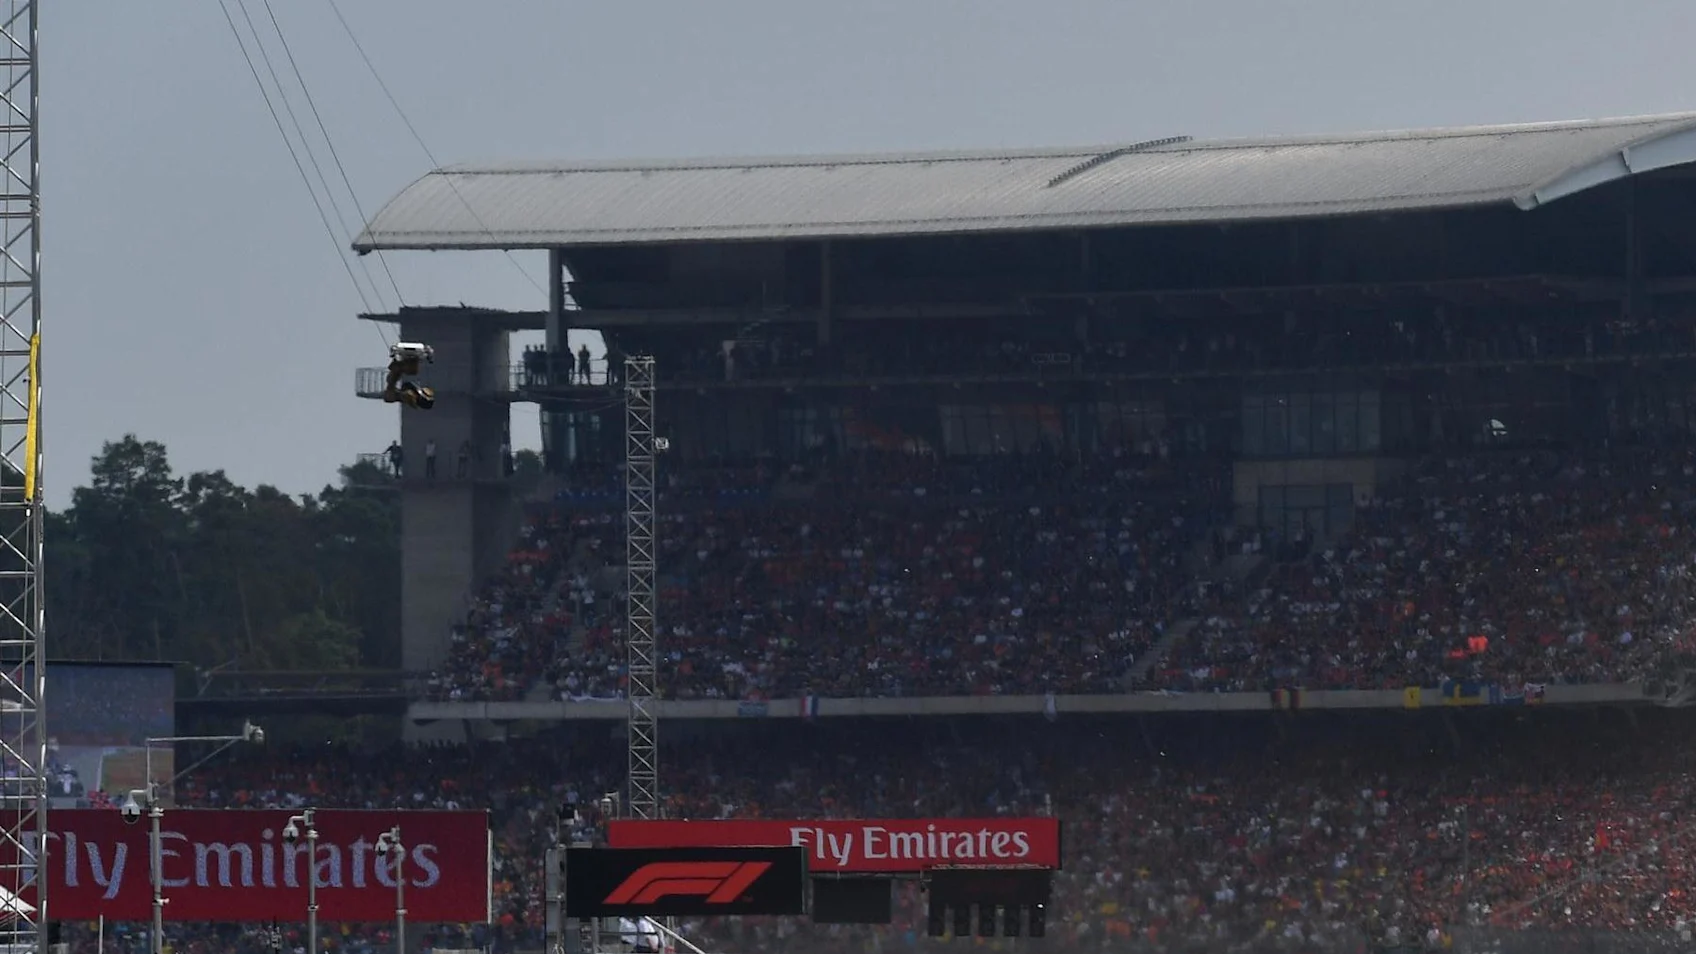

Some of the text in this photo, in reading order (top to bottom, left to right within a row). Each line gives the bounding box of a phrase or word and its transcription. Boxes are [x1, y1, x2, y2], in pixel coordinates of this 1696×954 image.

[21, 828, 441, 900] Fly Emirates
[790, 824, 1029, 866] Fly Emirates
